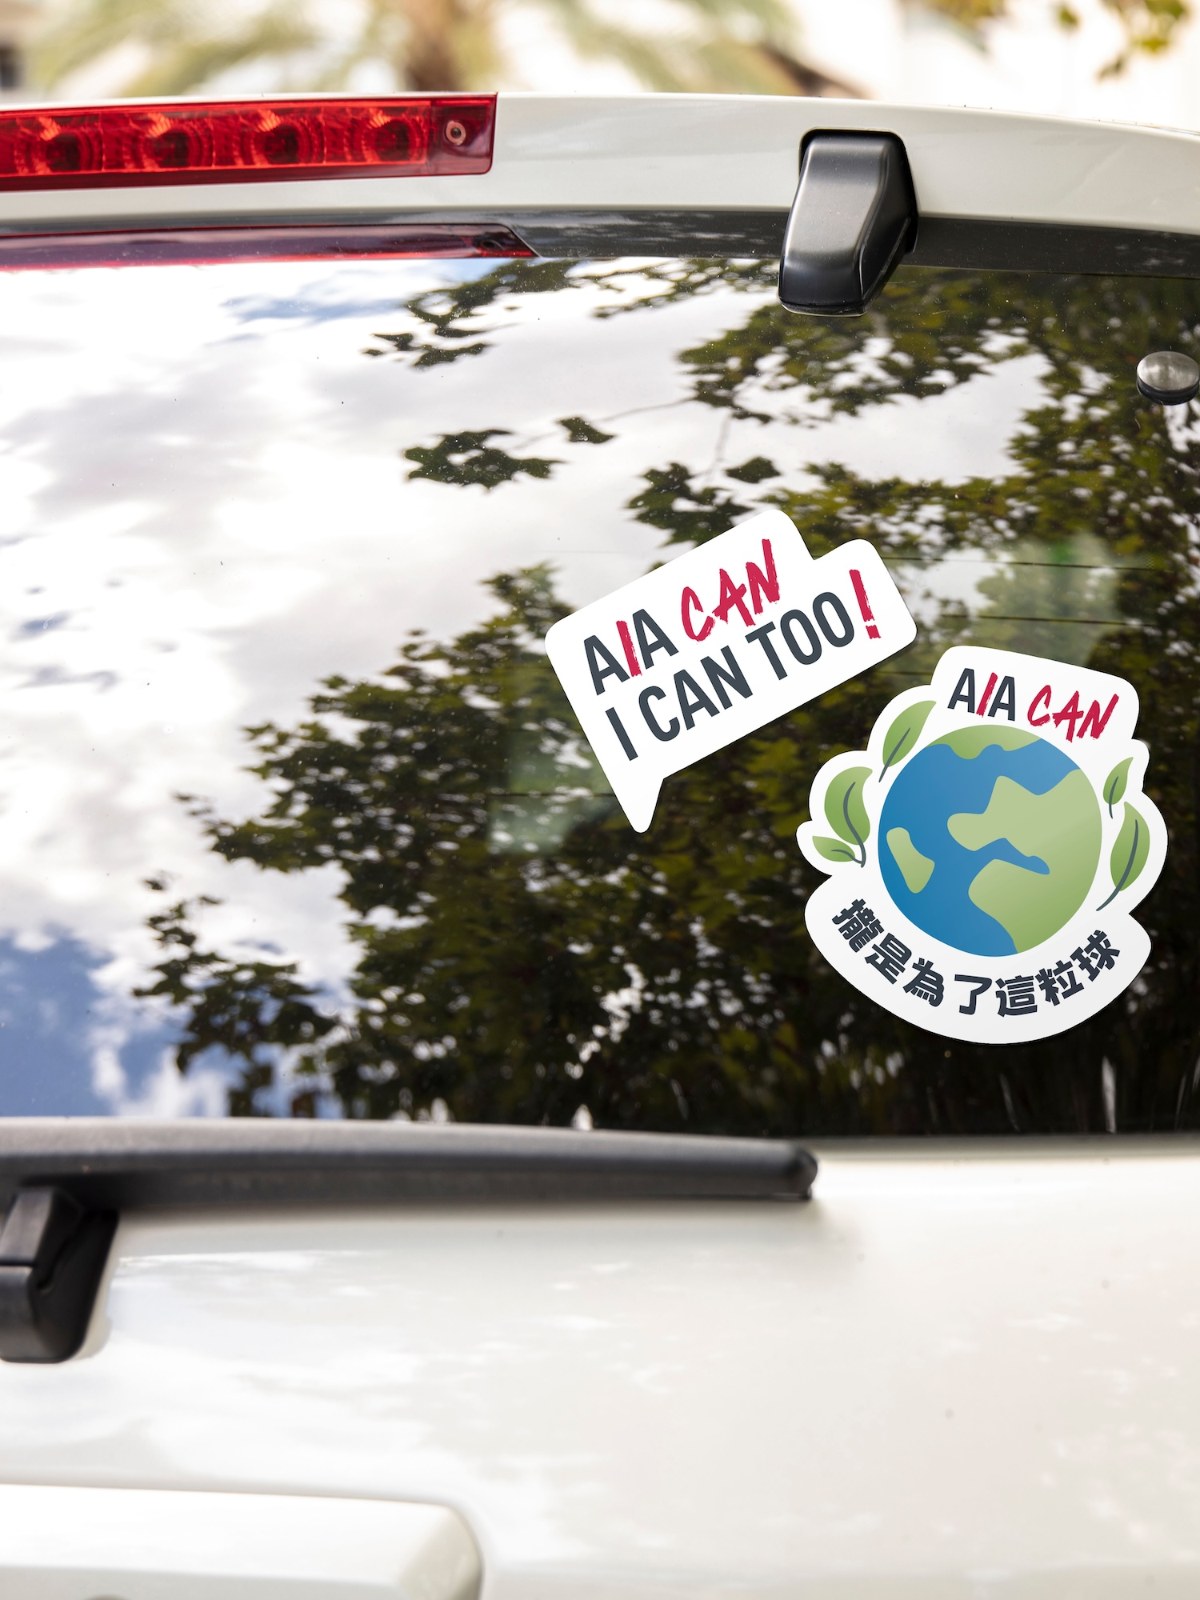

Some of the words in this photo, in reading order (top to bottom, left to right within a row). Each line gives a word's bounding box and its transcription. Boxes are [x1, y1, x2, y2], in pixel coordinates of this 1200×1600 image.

[583, 608, 680, 696] AIA
[680, 538, 781, 642] CAN
[604, 706, 639, 762] I
[638, 644, 754, 742] CAN
[744, 568, 881, 681] TOO!
[947, 667, 1016, 722] AIA
[1026, 684, 1120, 743] CAN
[831, 898, 1121, 1018] 攏是為了這粒球
